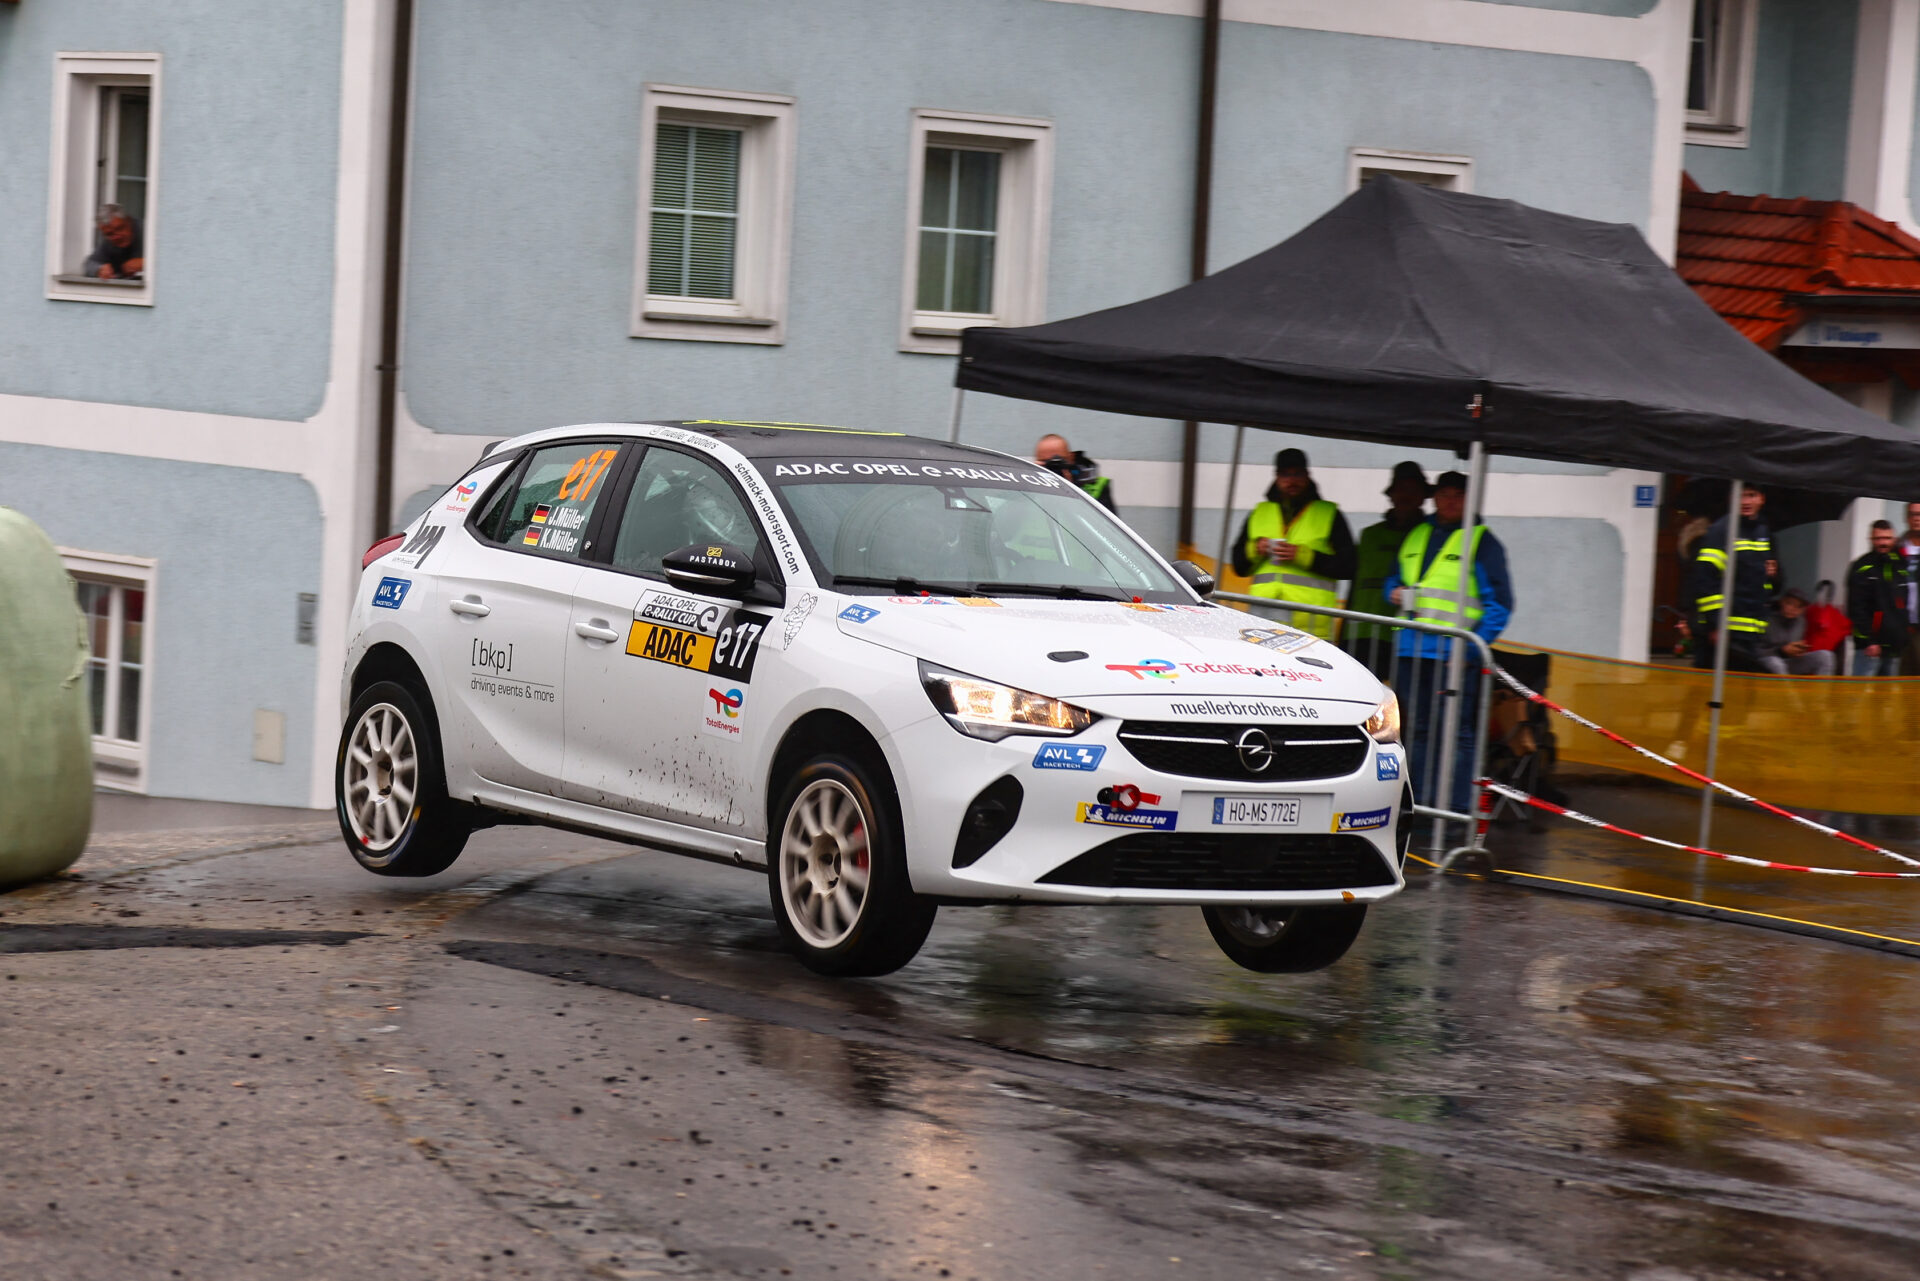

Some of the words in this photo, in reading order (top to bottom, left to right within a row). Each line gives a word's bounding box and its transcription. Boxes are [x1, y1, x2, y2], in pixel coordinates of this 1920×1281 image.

[558, 449, 619, 501] e17
[775, 463, 849, 476] ADAC
[852, 463, 920, 476] OPEL
[921, 466, 1019, 482] e-RALLY
[1021, 471, 1060, 488] CUP
[548, 506, 585, 530] J.Müller
[540, 528, 579, 552] K.Müller
[689, 555, 736, 568] PASTABOX
[378, 585, 392, 597] AVL
[652, 595, 676, 608] ADAC
[676, 600, 699, 612] OPEL
[644, 605, 678, 622] e-RALLY
[678, 611, 697, 626] CUP
[642, 626, 697, 665] ADAC
[714, 622, 763, 669] e17
[471, 638, 513, 675] [bkp]
[1178, 662, 1323, 682] TotalEnergies
[471, 677, 496, 696] driving
[498, 684, 523, 697] events
[525, 685, 532, 699] &
[534, 690, 555, 702] more
[1170, 700, 1320, 719] muellerbrothers.de
[705, 717, 740, 734] TotalEnergies
[1044, 748, 1072, 760] AVL
[1379, 759, 1392, 771] AVL
[1106, 813, 1167, 825] MICHELIN
[1229, 802, 1268, 822] HO-MS
[1271, 803, 1297, 822] 772E
[1352, 814, 1387, 826] MICHELIN
